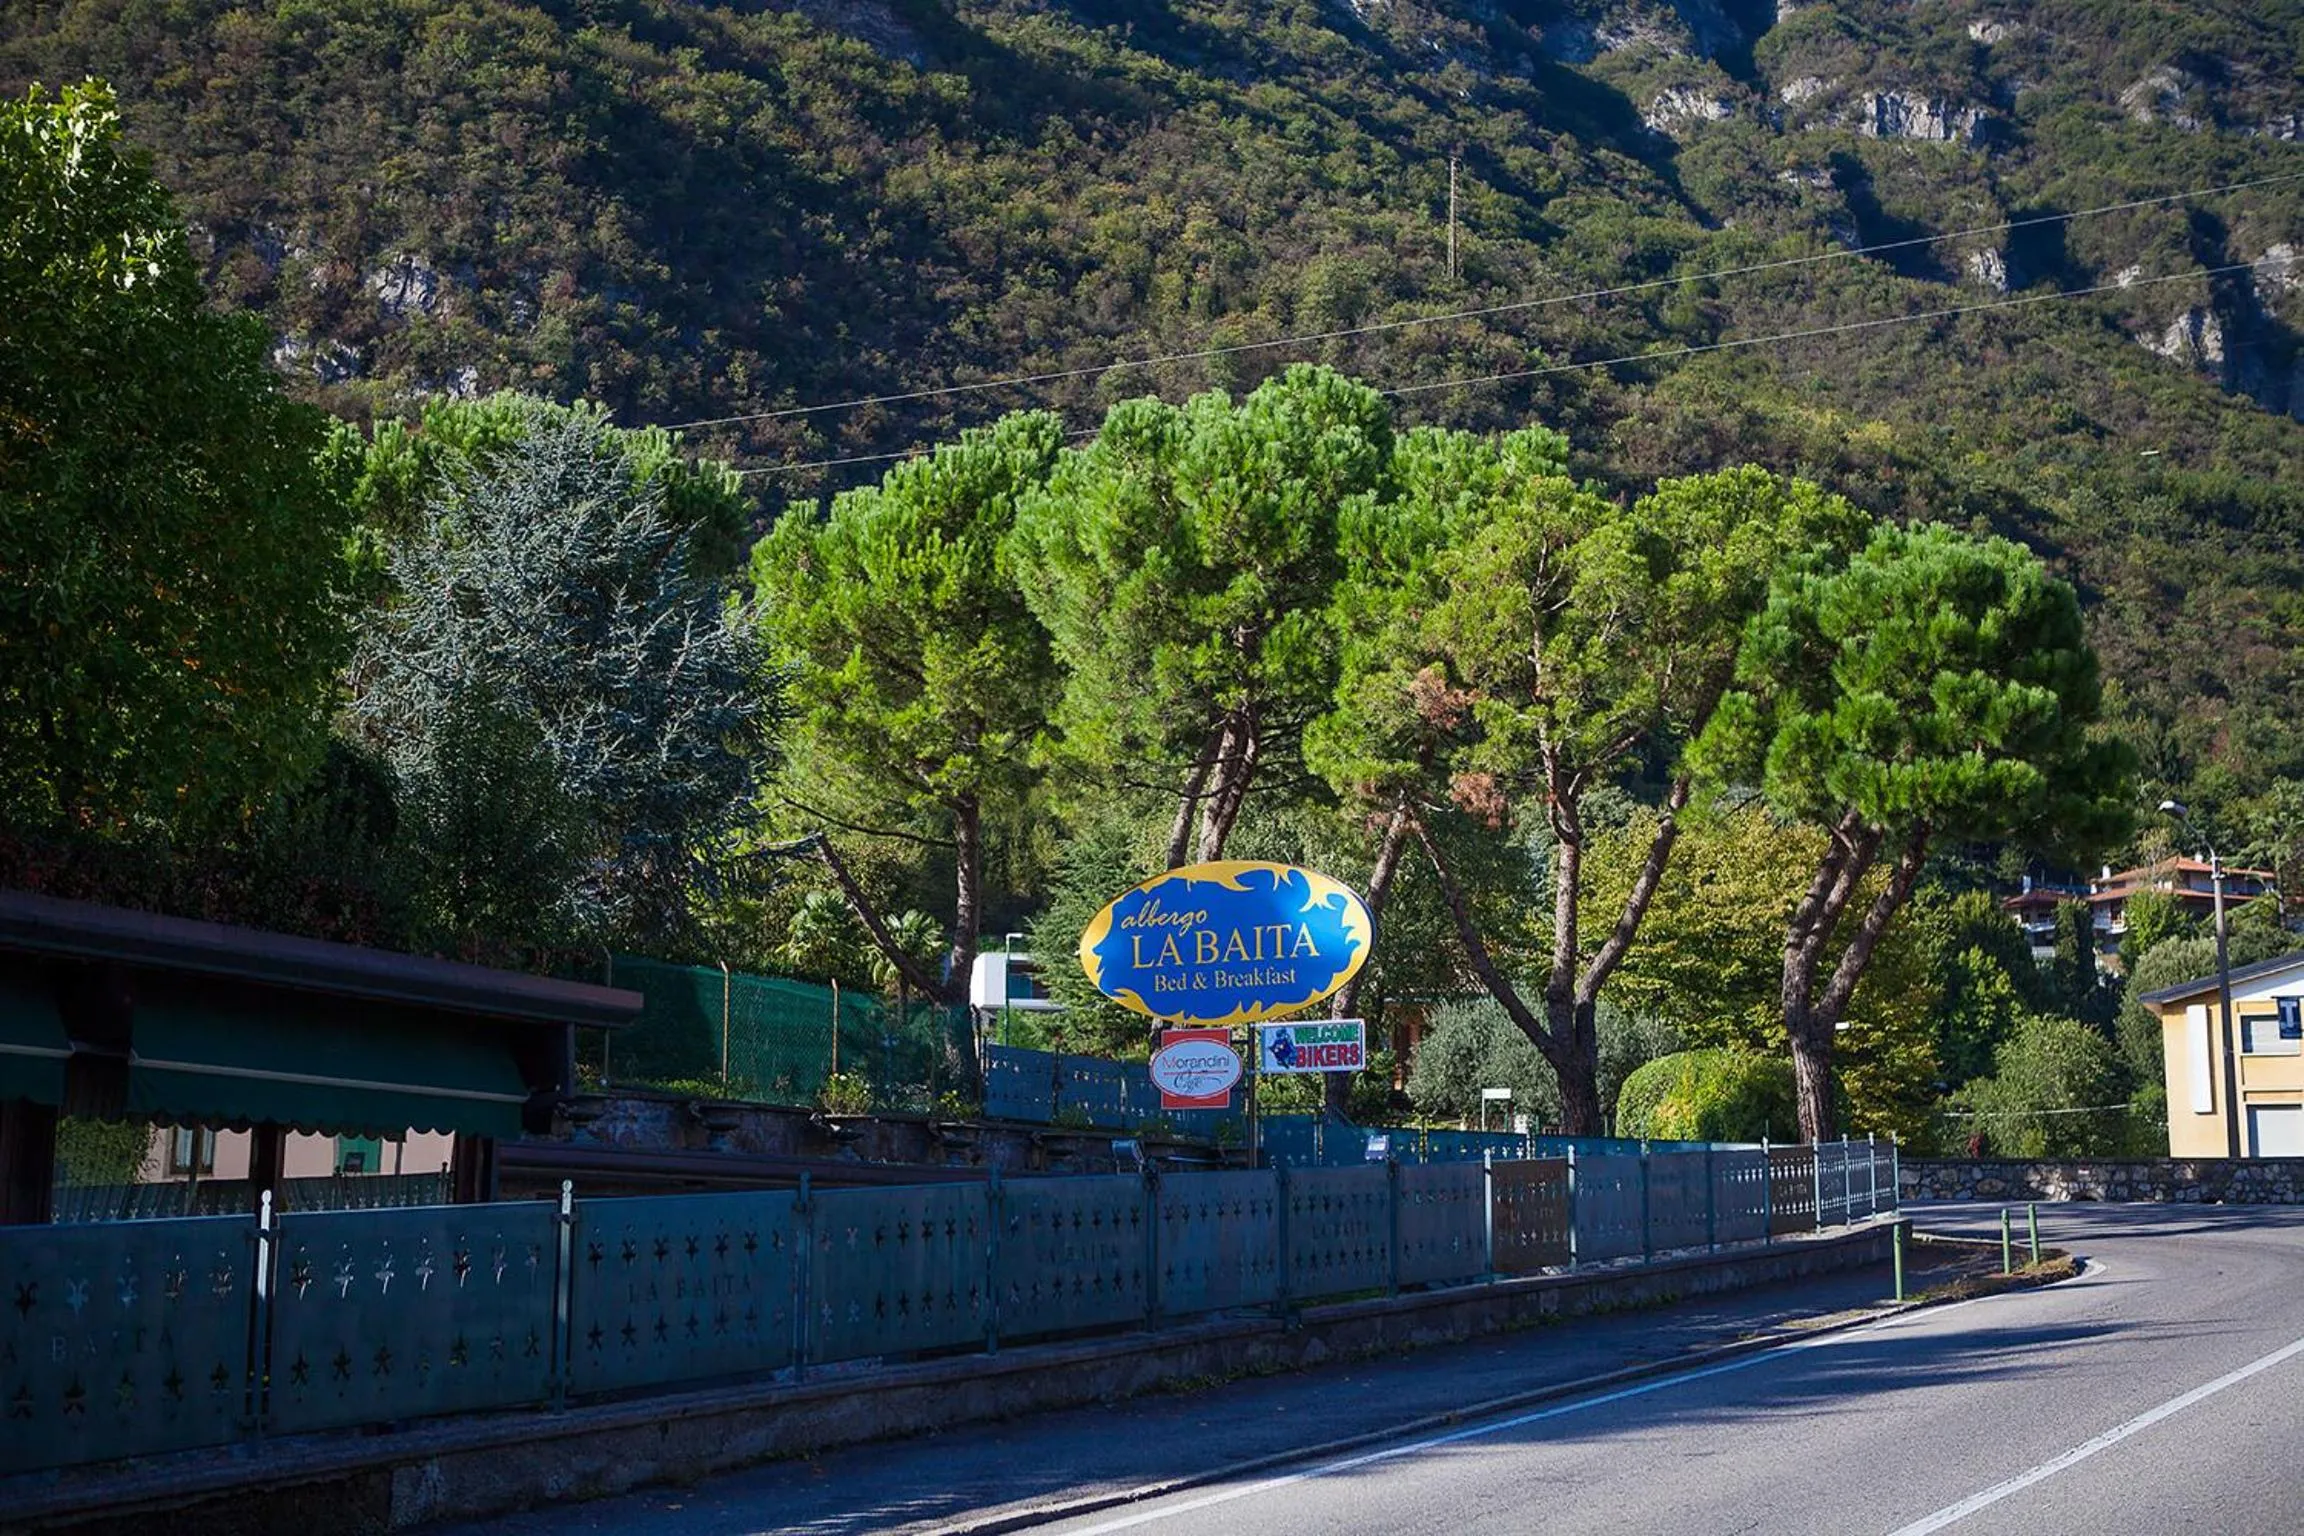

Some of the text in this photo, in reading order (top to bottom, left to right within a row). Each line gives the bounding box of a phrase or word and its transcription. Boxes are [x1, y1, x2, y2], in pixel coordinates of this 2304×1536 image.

[1121, 899, 1208, 937] albergo
[1132, 921, 1320, 969] LA BAITA
[1154, 965, 1297, 992] Bed & Breakfast
[1294, 1026, 1359, 1045] WELCOME
[1162, 1054, 1230, 1069] Morandini
[1295, 1043, 1360, 1069] BIKERS
